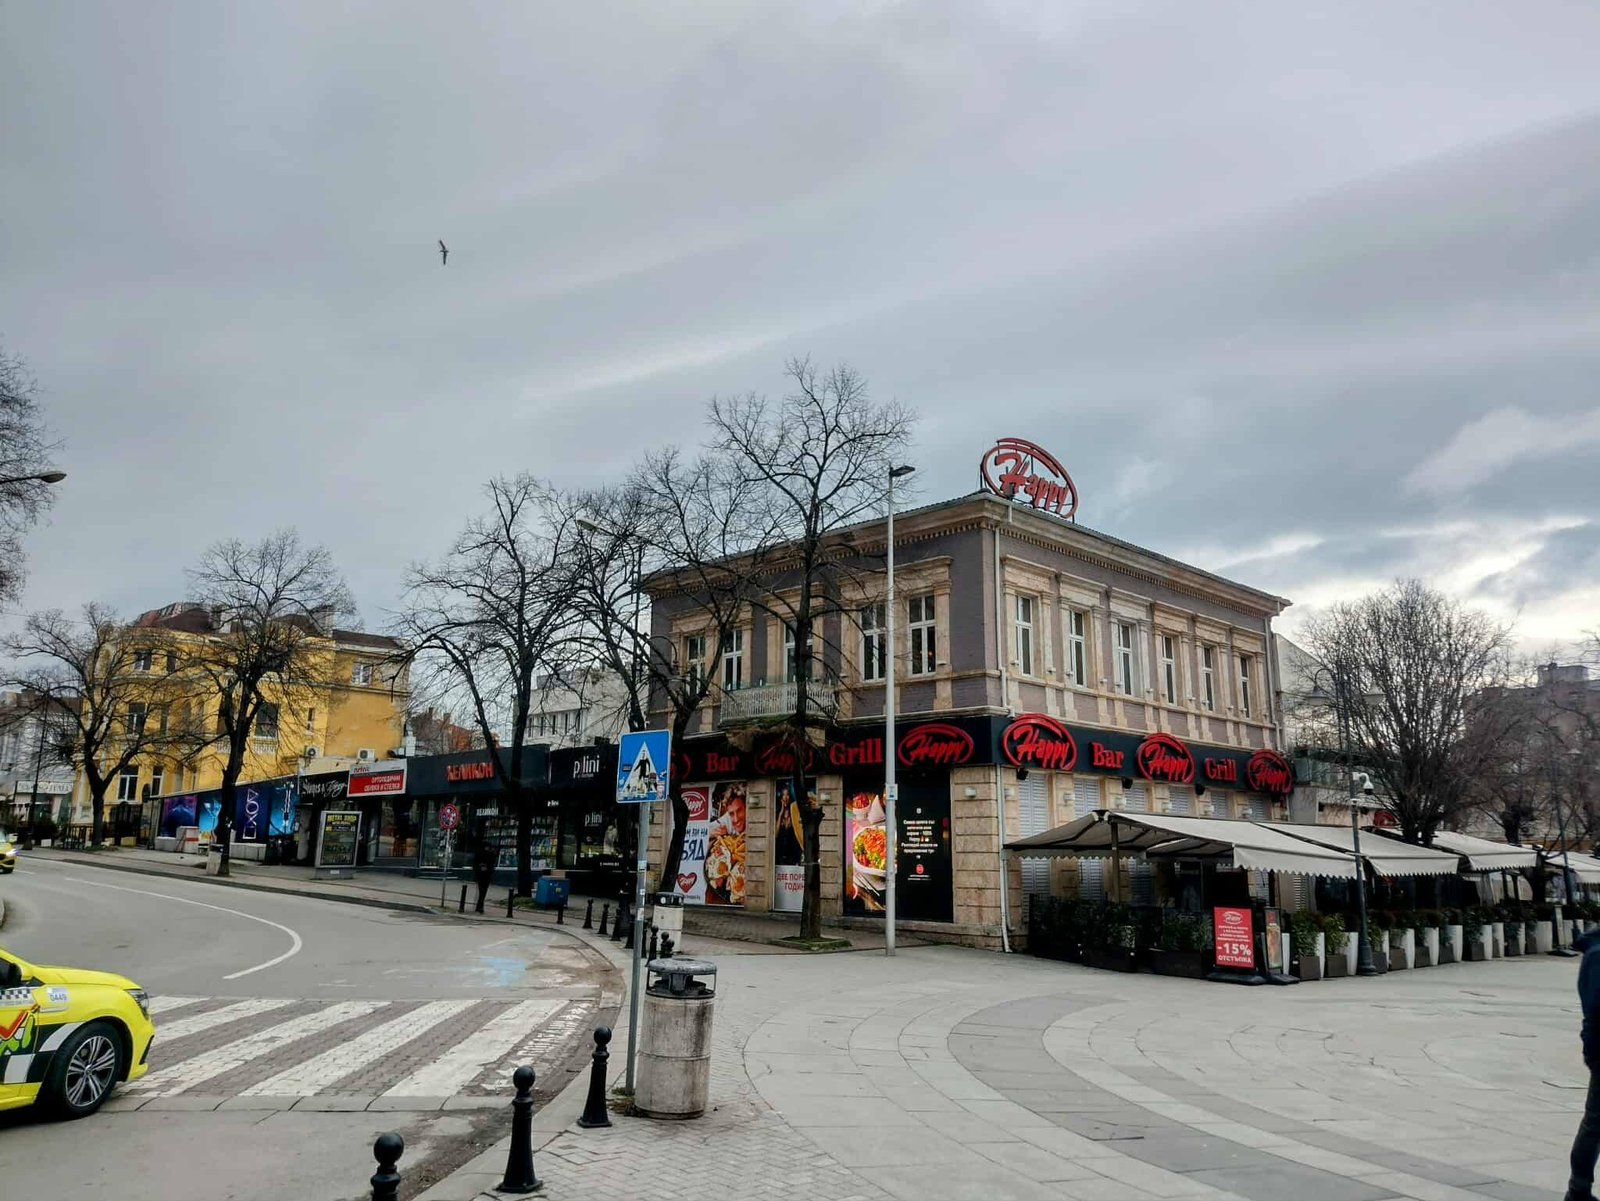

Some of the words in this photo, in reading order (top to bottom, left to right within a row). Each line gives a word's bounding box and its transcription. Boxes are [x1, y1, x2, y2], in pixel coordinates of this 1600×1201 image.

[993, 450, 1070, 514] Happy
[829, 738, 882, 765] Grill
[905, 734, 967, 764] Happy
[1012, 724, 1070, 769] Happy
[1091, 742, 1125, 769] Bar
[706, 752, 739, 774] Bar
[1144, 744, 1191, 783] Happy
[1204, 756, 1238, 782] Grill
[1218, 943, 1252, 957] -15%
